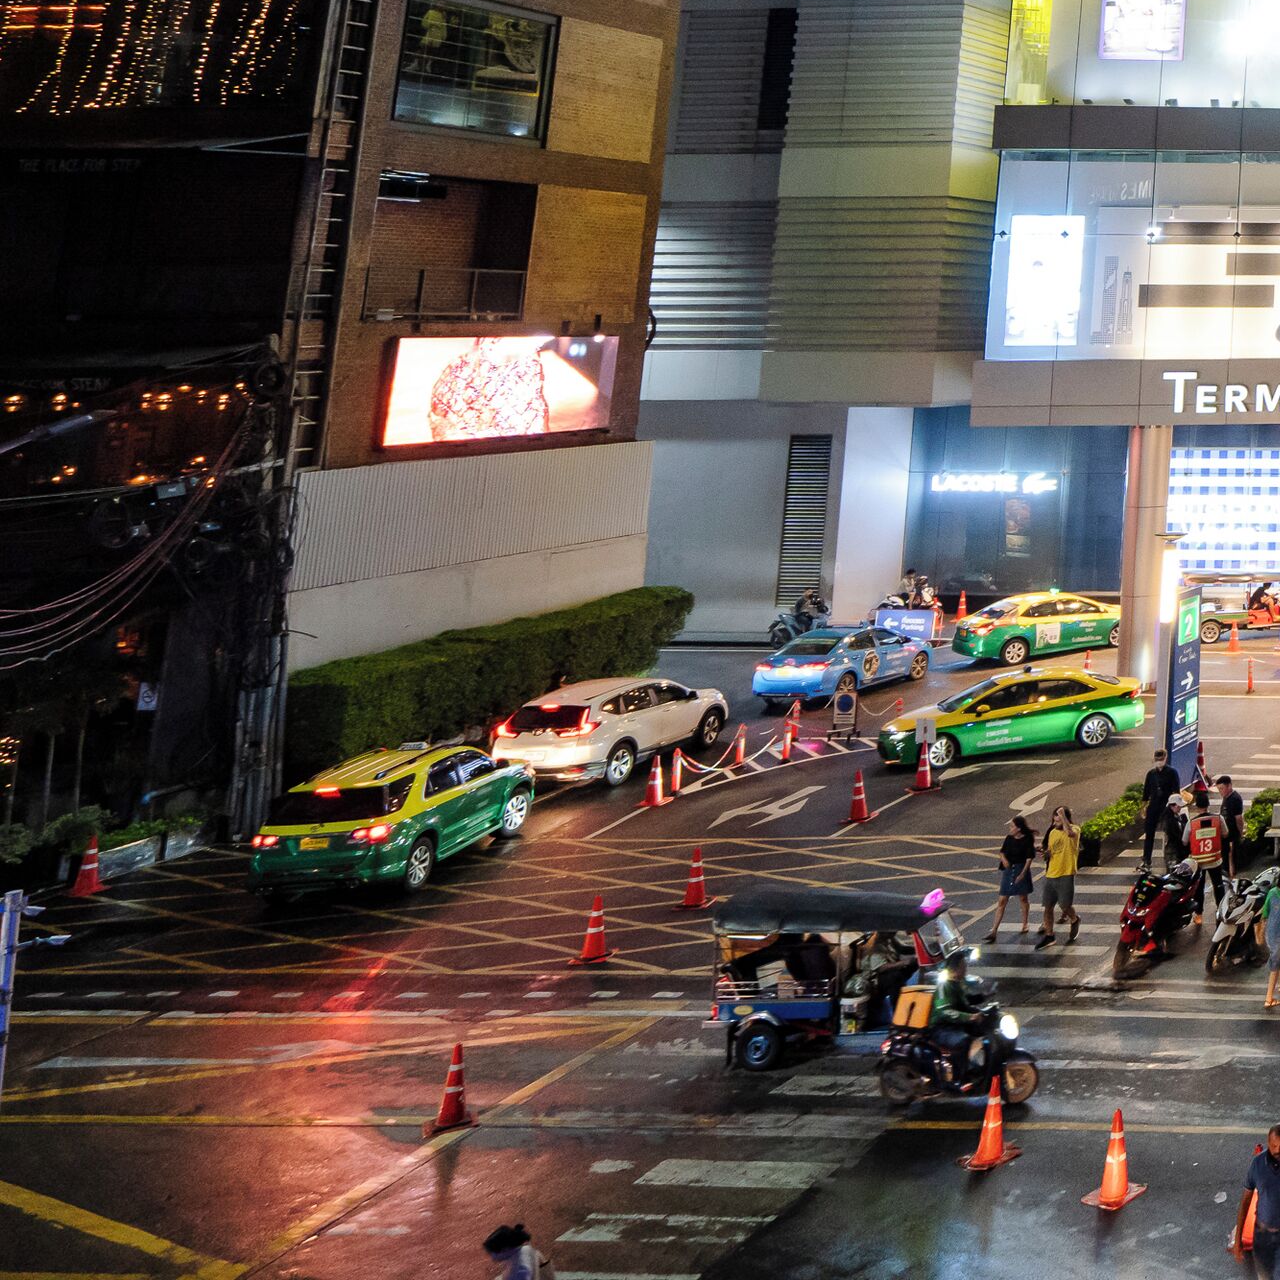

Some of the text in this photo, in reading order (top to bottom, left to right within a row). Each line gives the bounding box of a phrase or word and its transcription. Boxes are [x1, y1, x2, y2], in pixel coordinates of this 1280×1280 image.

[931, 474, 1018, 492] LACOSTE
[901, 623, 925, 632] Parking
[1184, 613, 1193, 637] 2
[1200, 839, 1213, 853] 13
